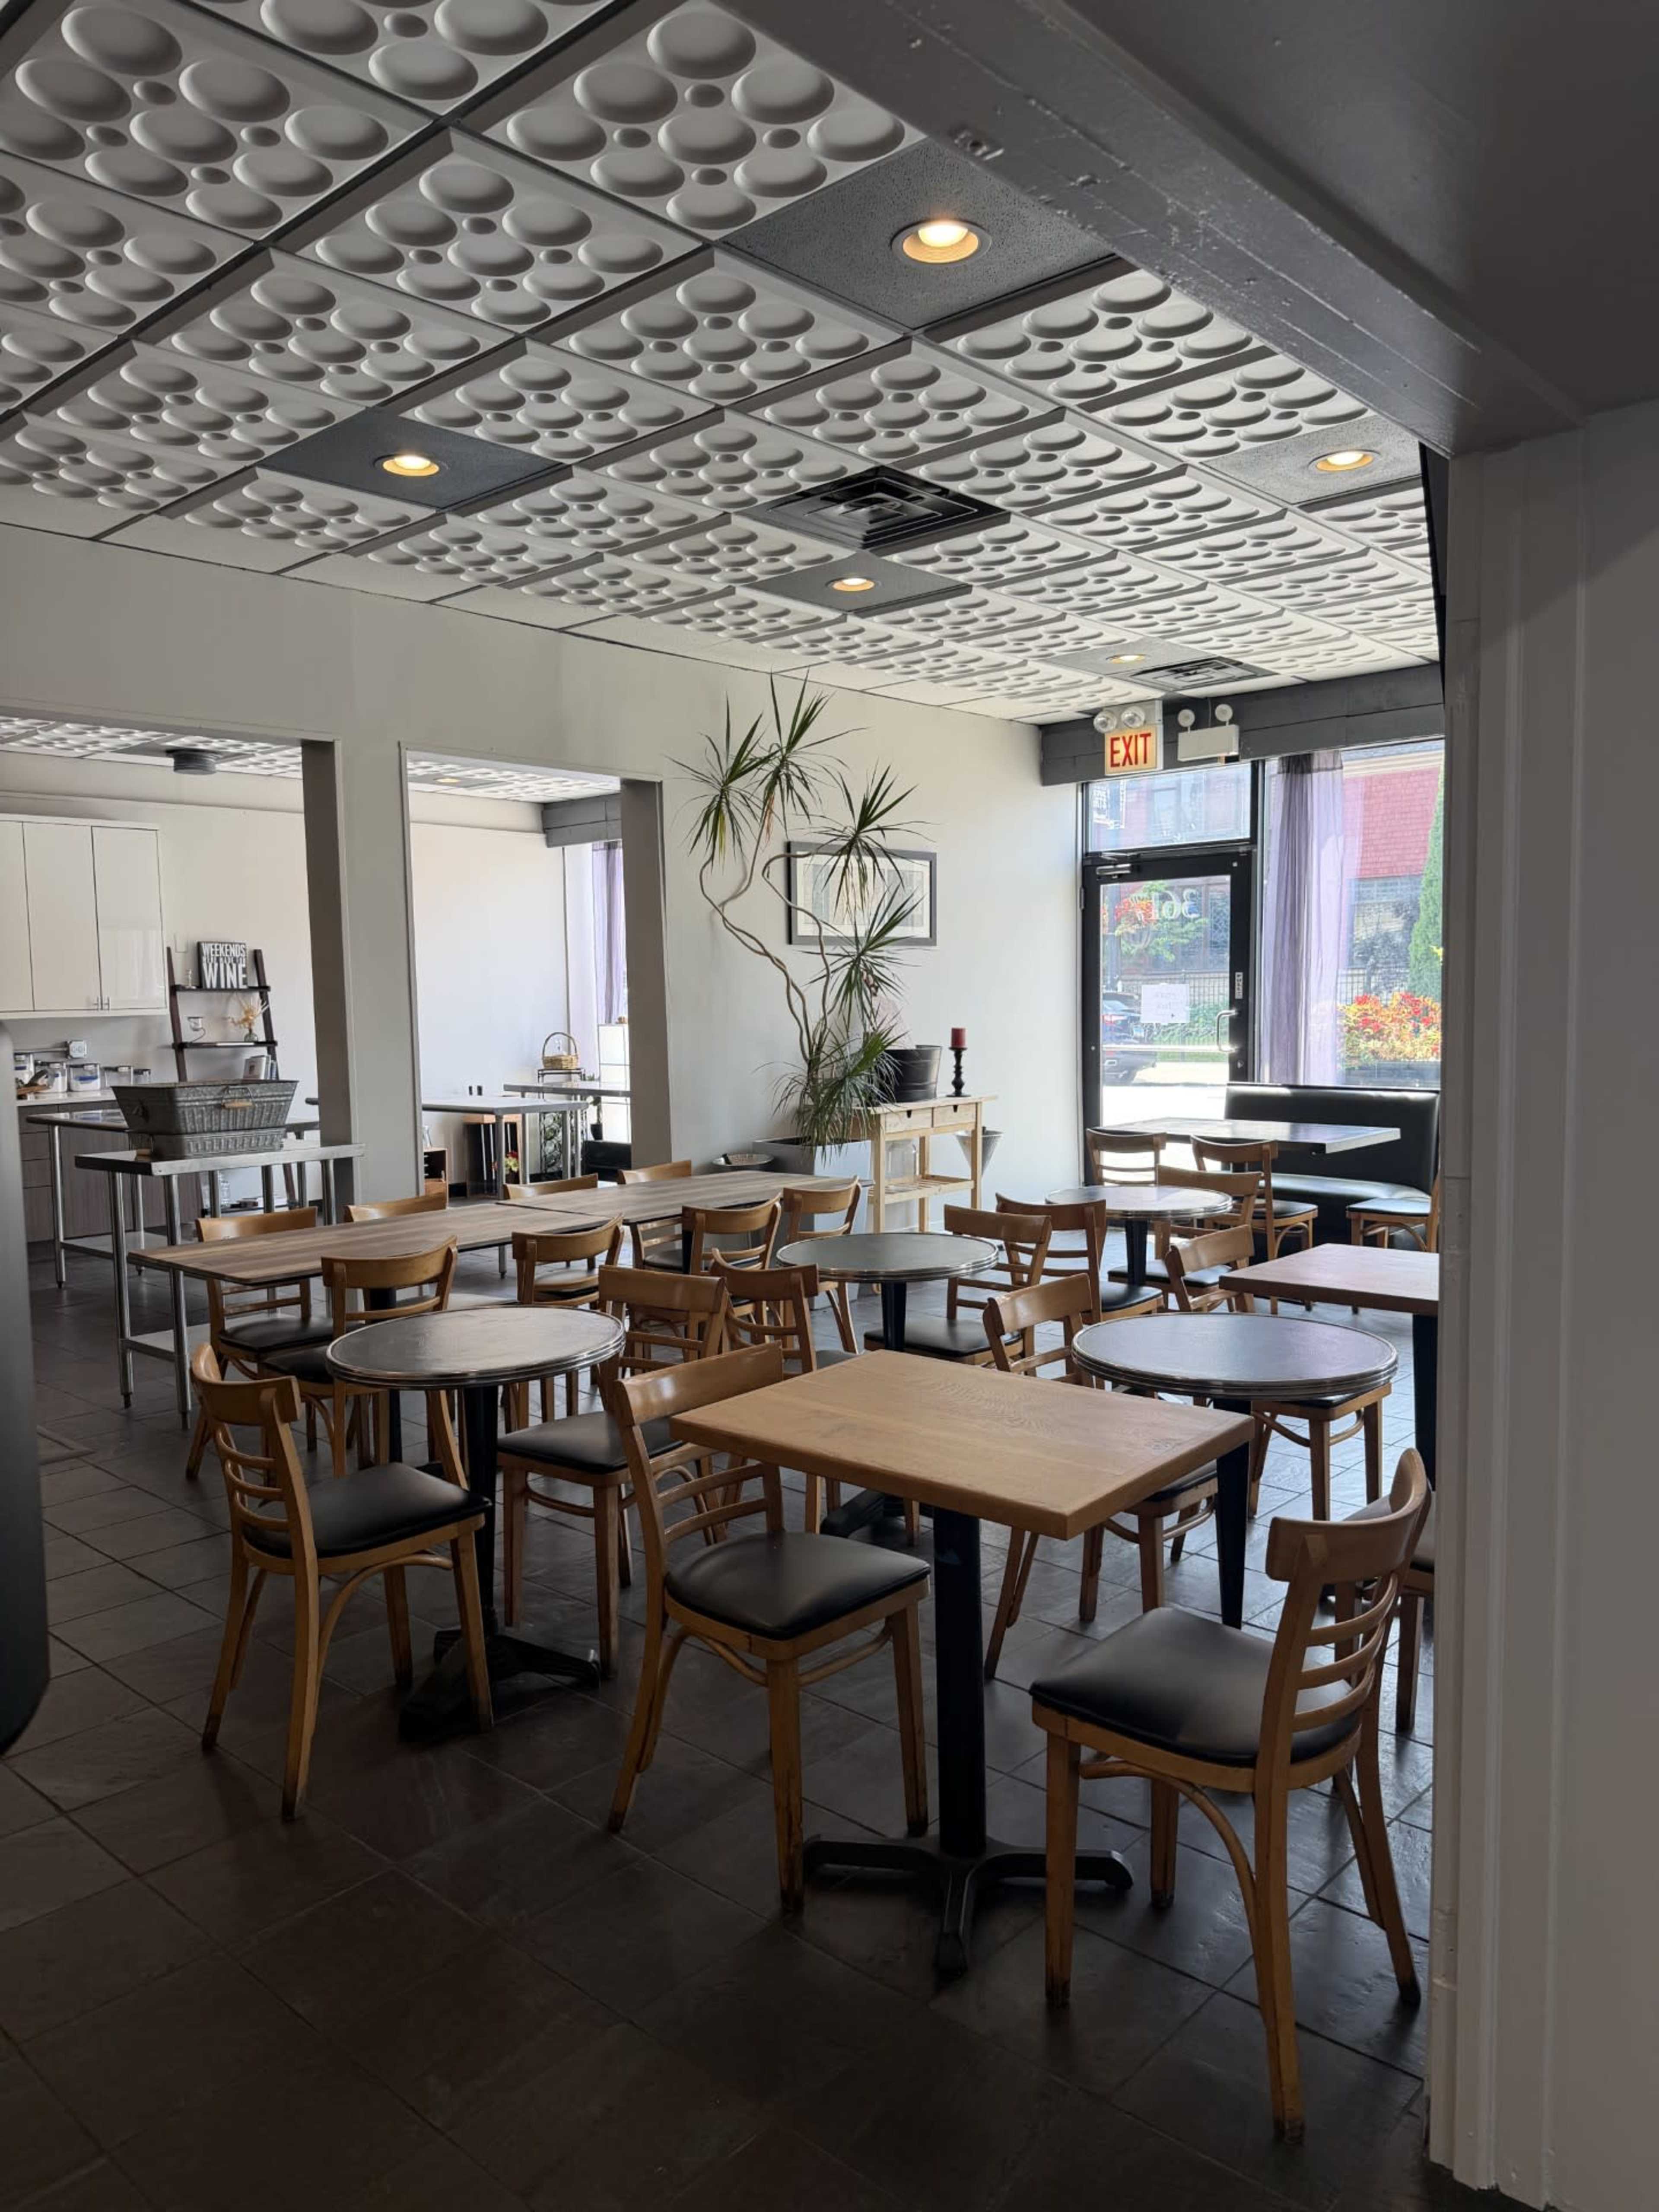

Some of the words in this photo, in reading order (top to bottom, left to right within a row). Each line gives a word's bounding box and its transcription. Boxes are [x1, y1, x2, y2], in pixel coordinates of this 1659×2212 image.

[1110, 733, 1151, 767] EXIT
[202, 943, 246, 957] WEEKENDS
[203, 963, 247, 988] WINE
